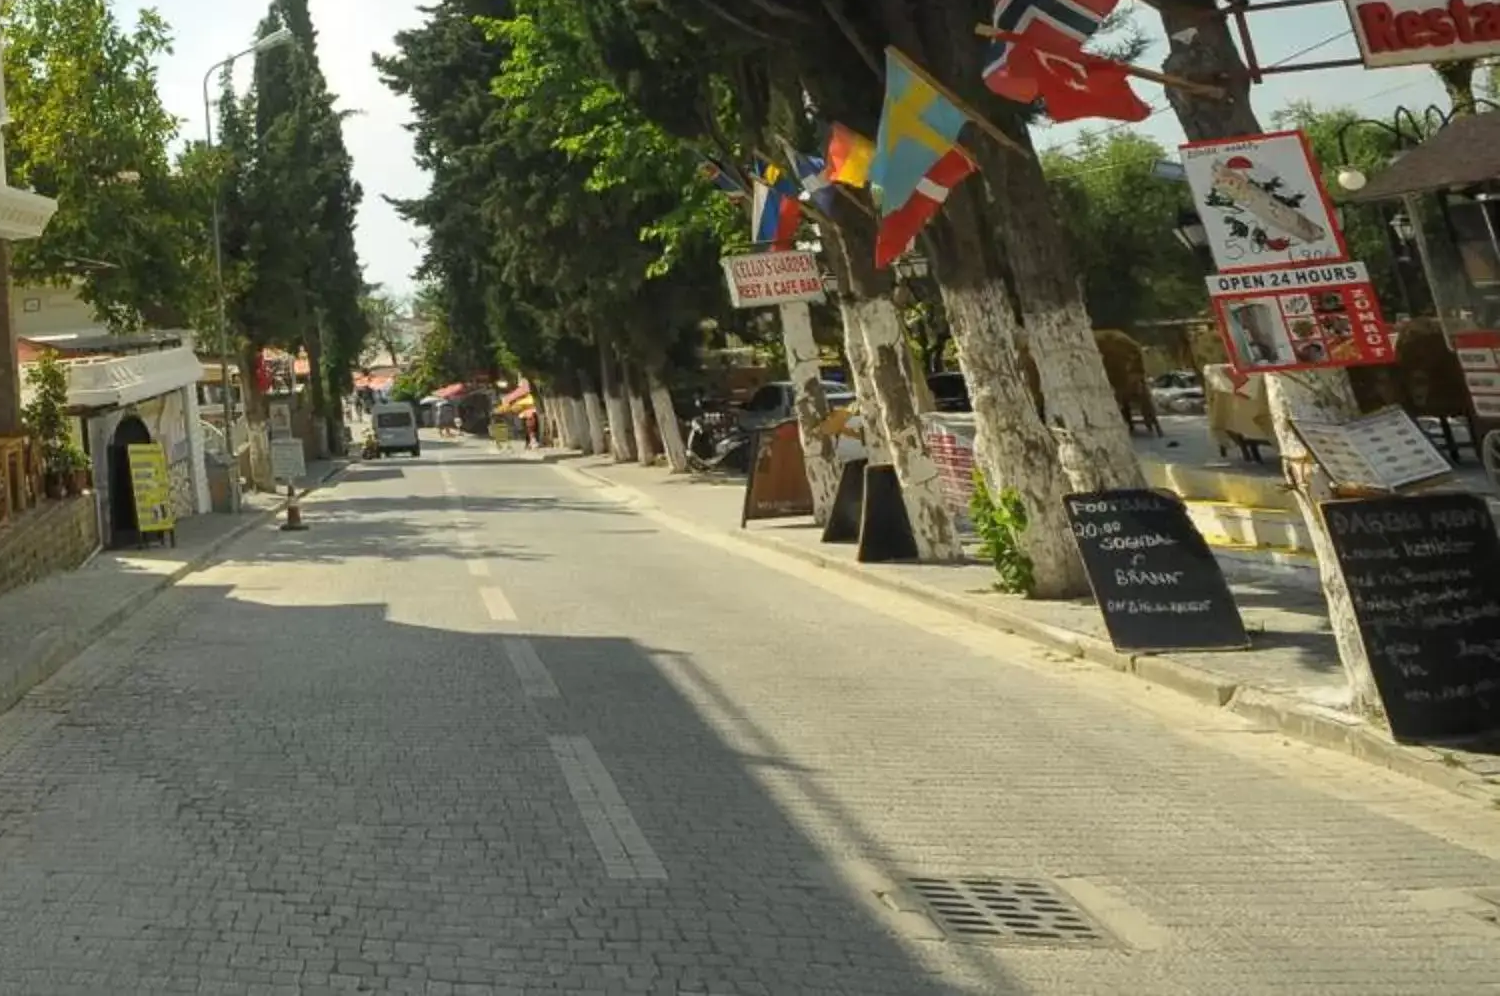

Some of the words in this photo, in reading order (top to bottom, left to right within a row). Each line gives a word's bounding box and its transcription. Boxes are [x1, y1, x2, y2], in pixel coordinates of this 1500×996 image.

[773, 254, 815, 276] GARDEN
[773, 279, 798, 296] CAFE
[799, 276, 822, 292] BAR
[1218, 275, 1266, 292] OPEN
[1271, 273, 1291, 287] 24
[1295, 265, 1358, 285] HOURS
